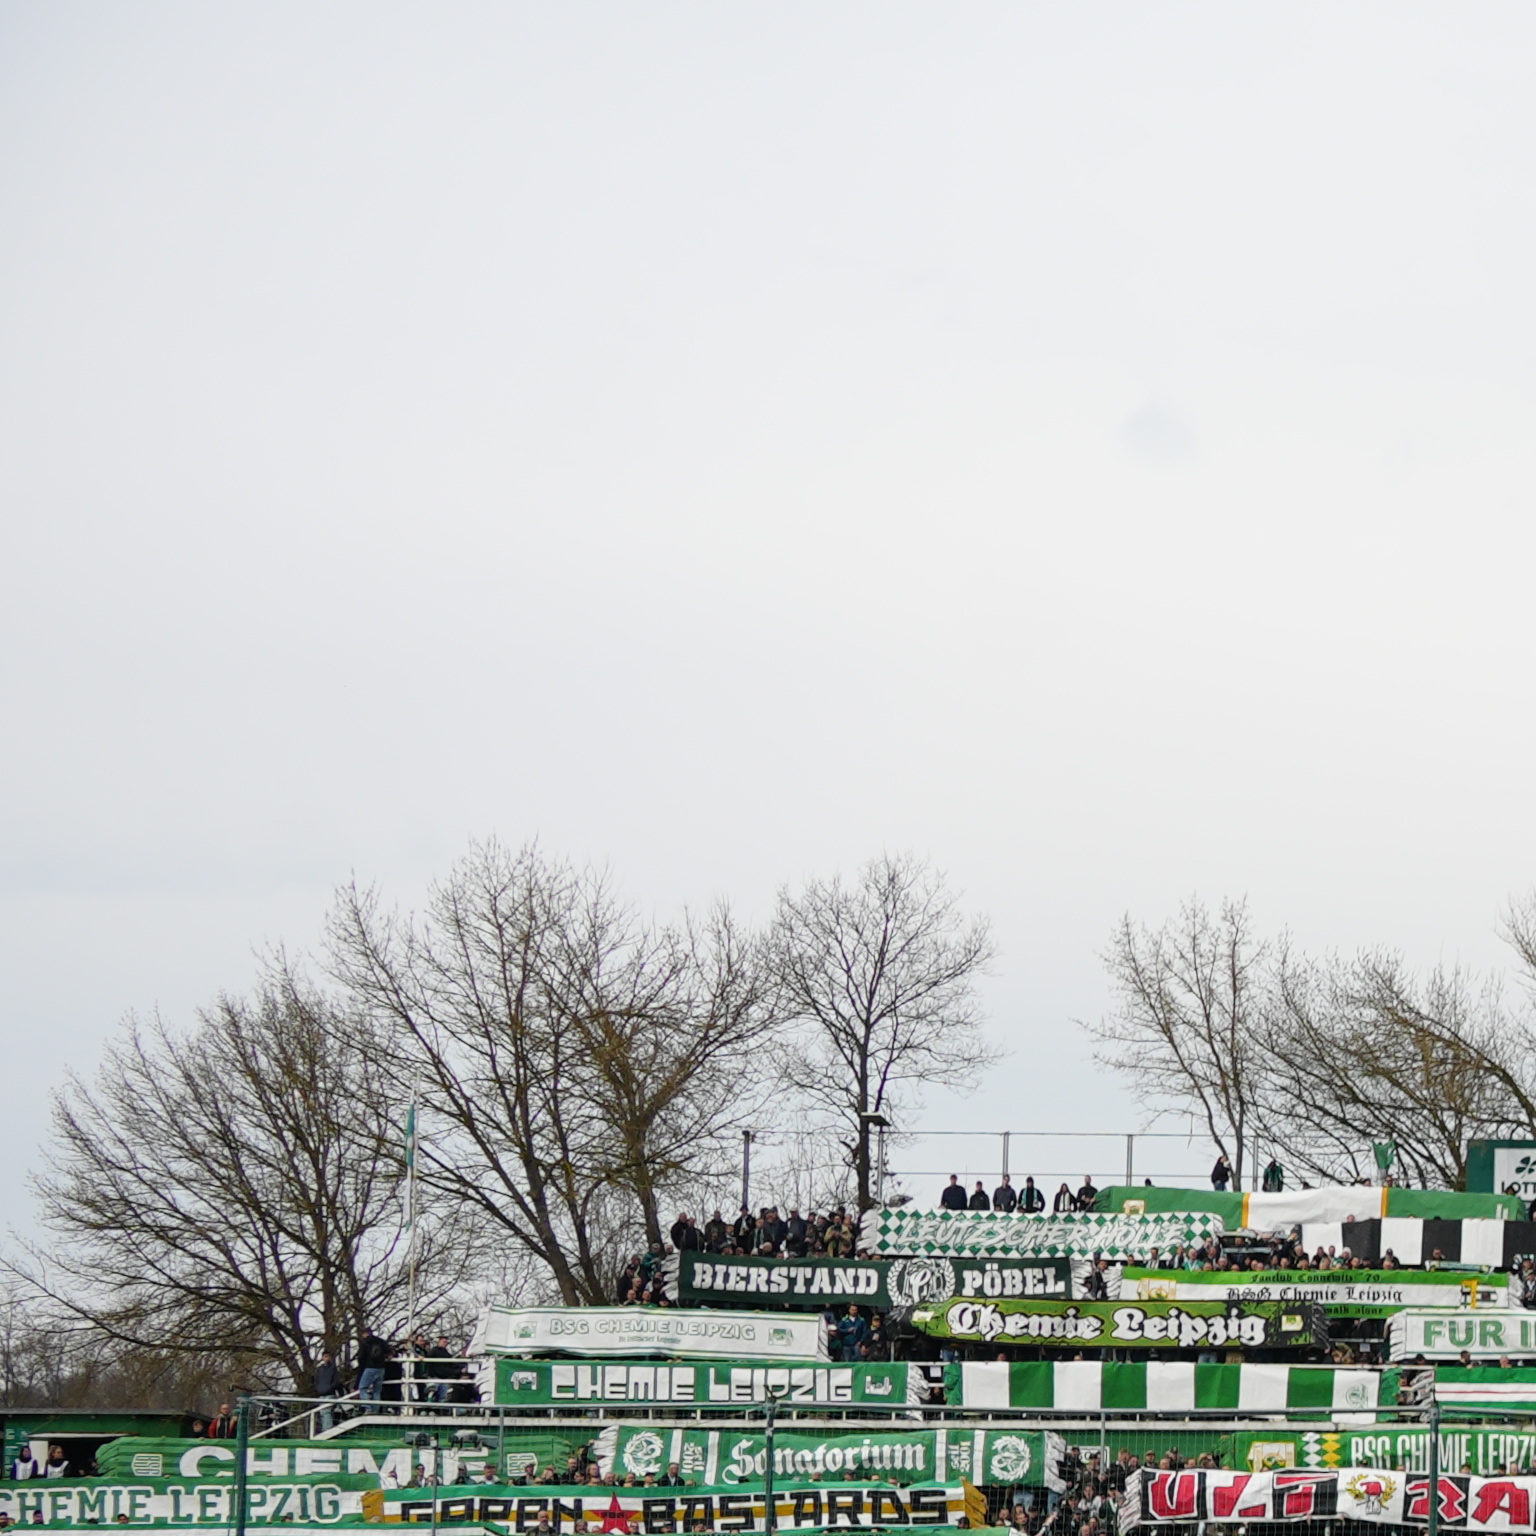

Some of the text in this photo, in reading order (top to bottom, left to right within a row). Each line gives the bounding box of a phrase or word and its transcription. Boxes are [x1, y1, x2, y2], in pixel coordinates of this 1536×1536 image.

[902, 1215, 1186, 1250] LEUTZSCHER HÖLLE
[693, 1263, 1066, 1297] BIERSTAND PÖBEL
[1280, 1286, 1338, 1302] Chemie
[1346, 1285, 1403, 1303] Leipzig
[550, 1317, 589, 1336] BSG
[595, 1319, 670, 1334] CHEMIE
[676, 1321, 756, 1341] LEIPZIG
[948, 1302, 1267, 1348] Chemie Leipzig
[551, 1365, 853, 1402] CHEMIE LEIPZIG
[179, 1445, 488, 1489] CHEMIE
[1351, 1436, 1390, 1472] BSG
[1397, 1436, 1471, 1474] CHMIE
[167, 1483, 342, 1524] LEIPZIG
[643, 1490, 949, 1534] BASTARDS
